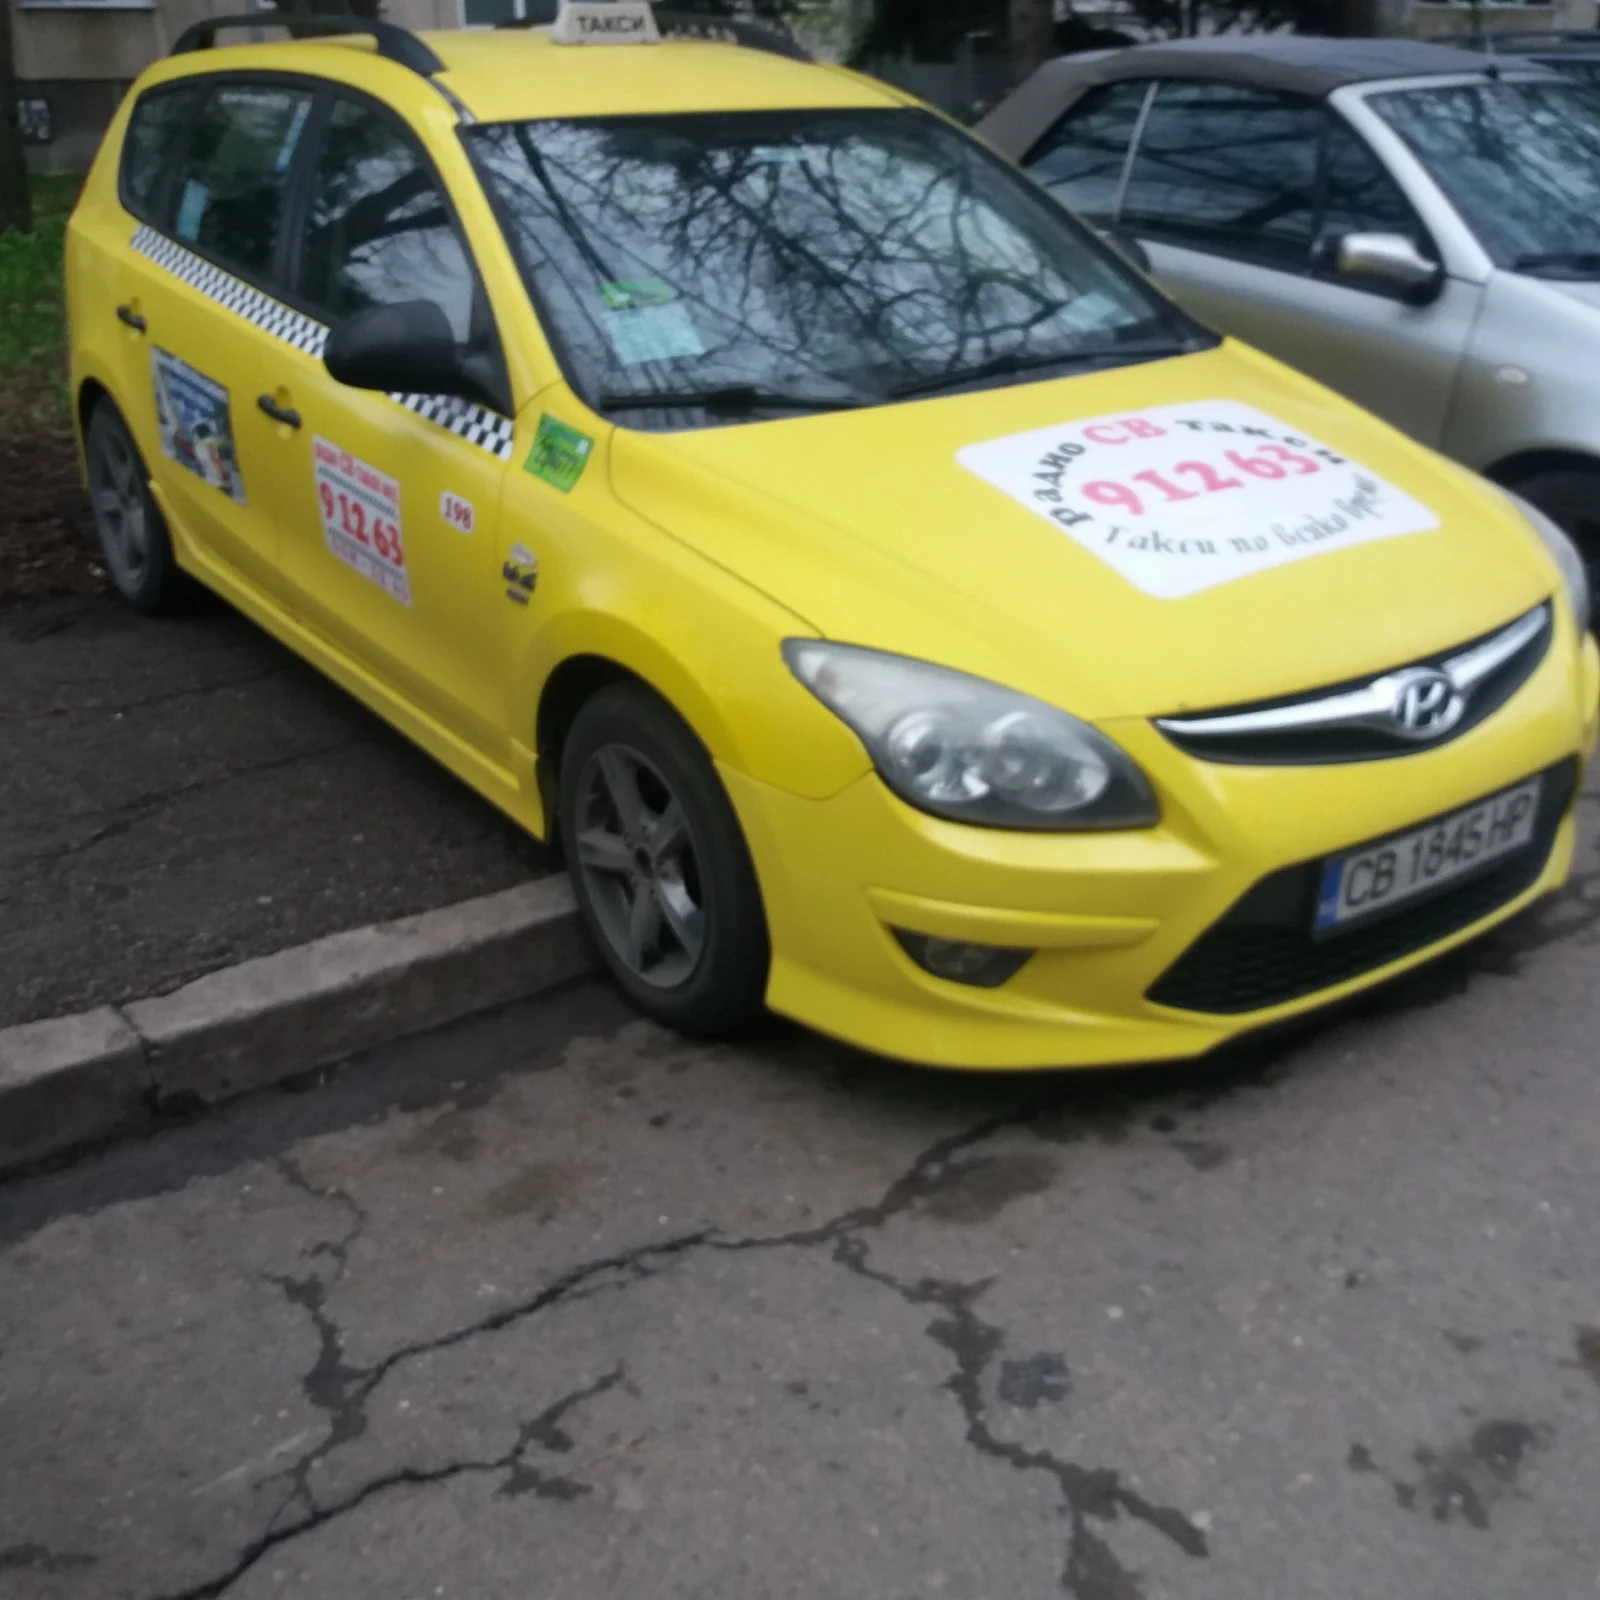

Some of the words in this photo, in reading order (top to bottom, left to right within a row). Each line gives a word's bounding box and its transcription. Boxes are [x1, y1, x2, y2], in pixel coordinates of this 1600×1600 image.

[576, 15, 644, 34] ТАКСИ
[1081, 418, 1167, 445] СВ
[444, 496, 472, 530] 198
[1229, 534, 1270, 554] по
